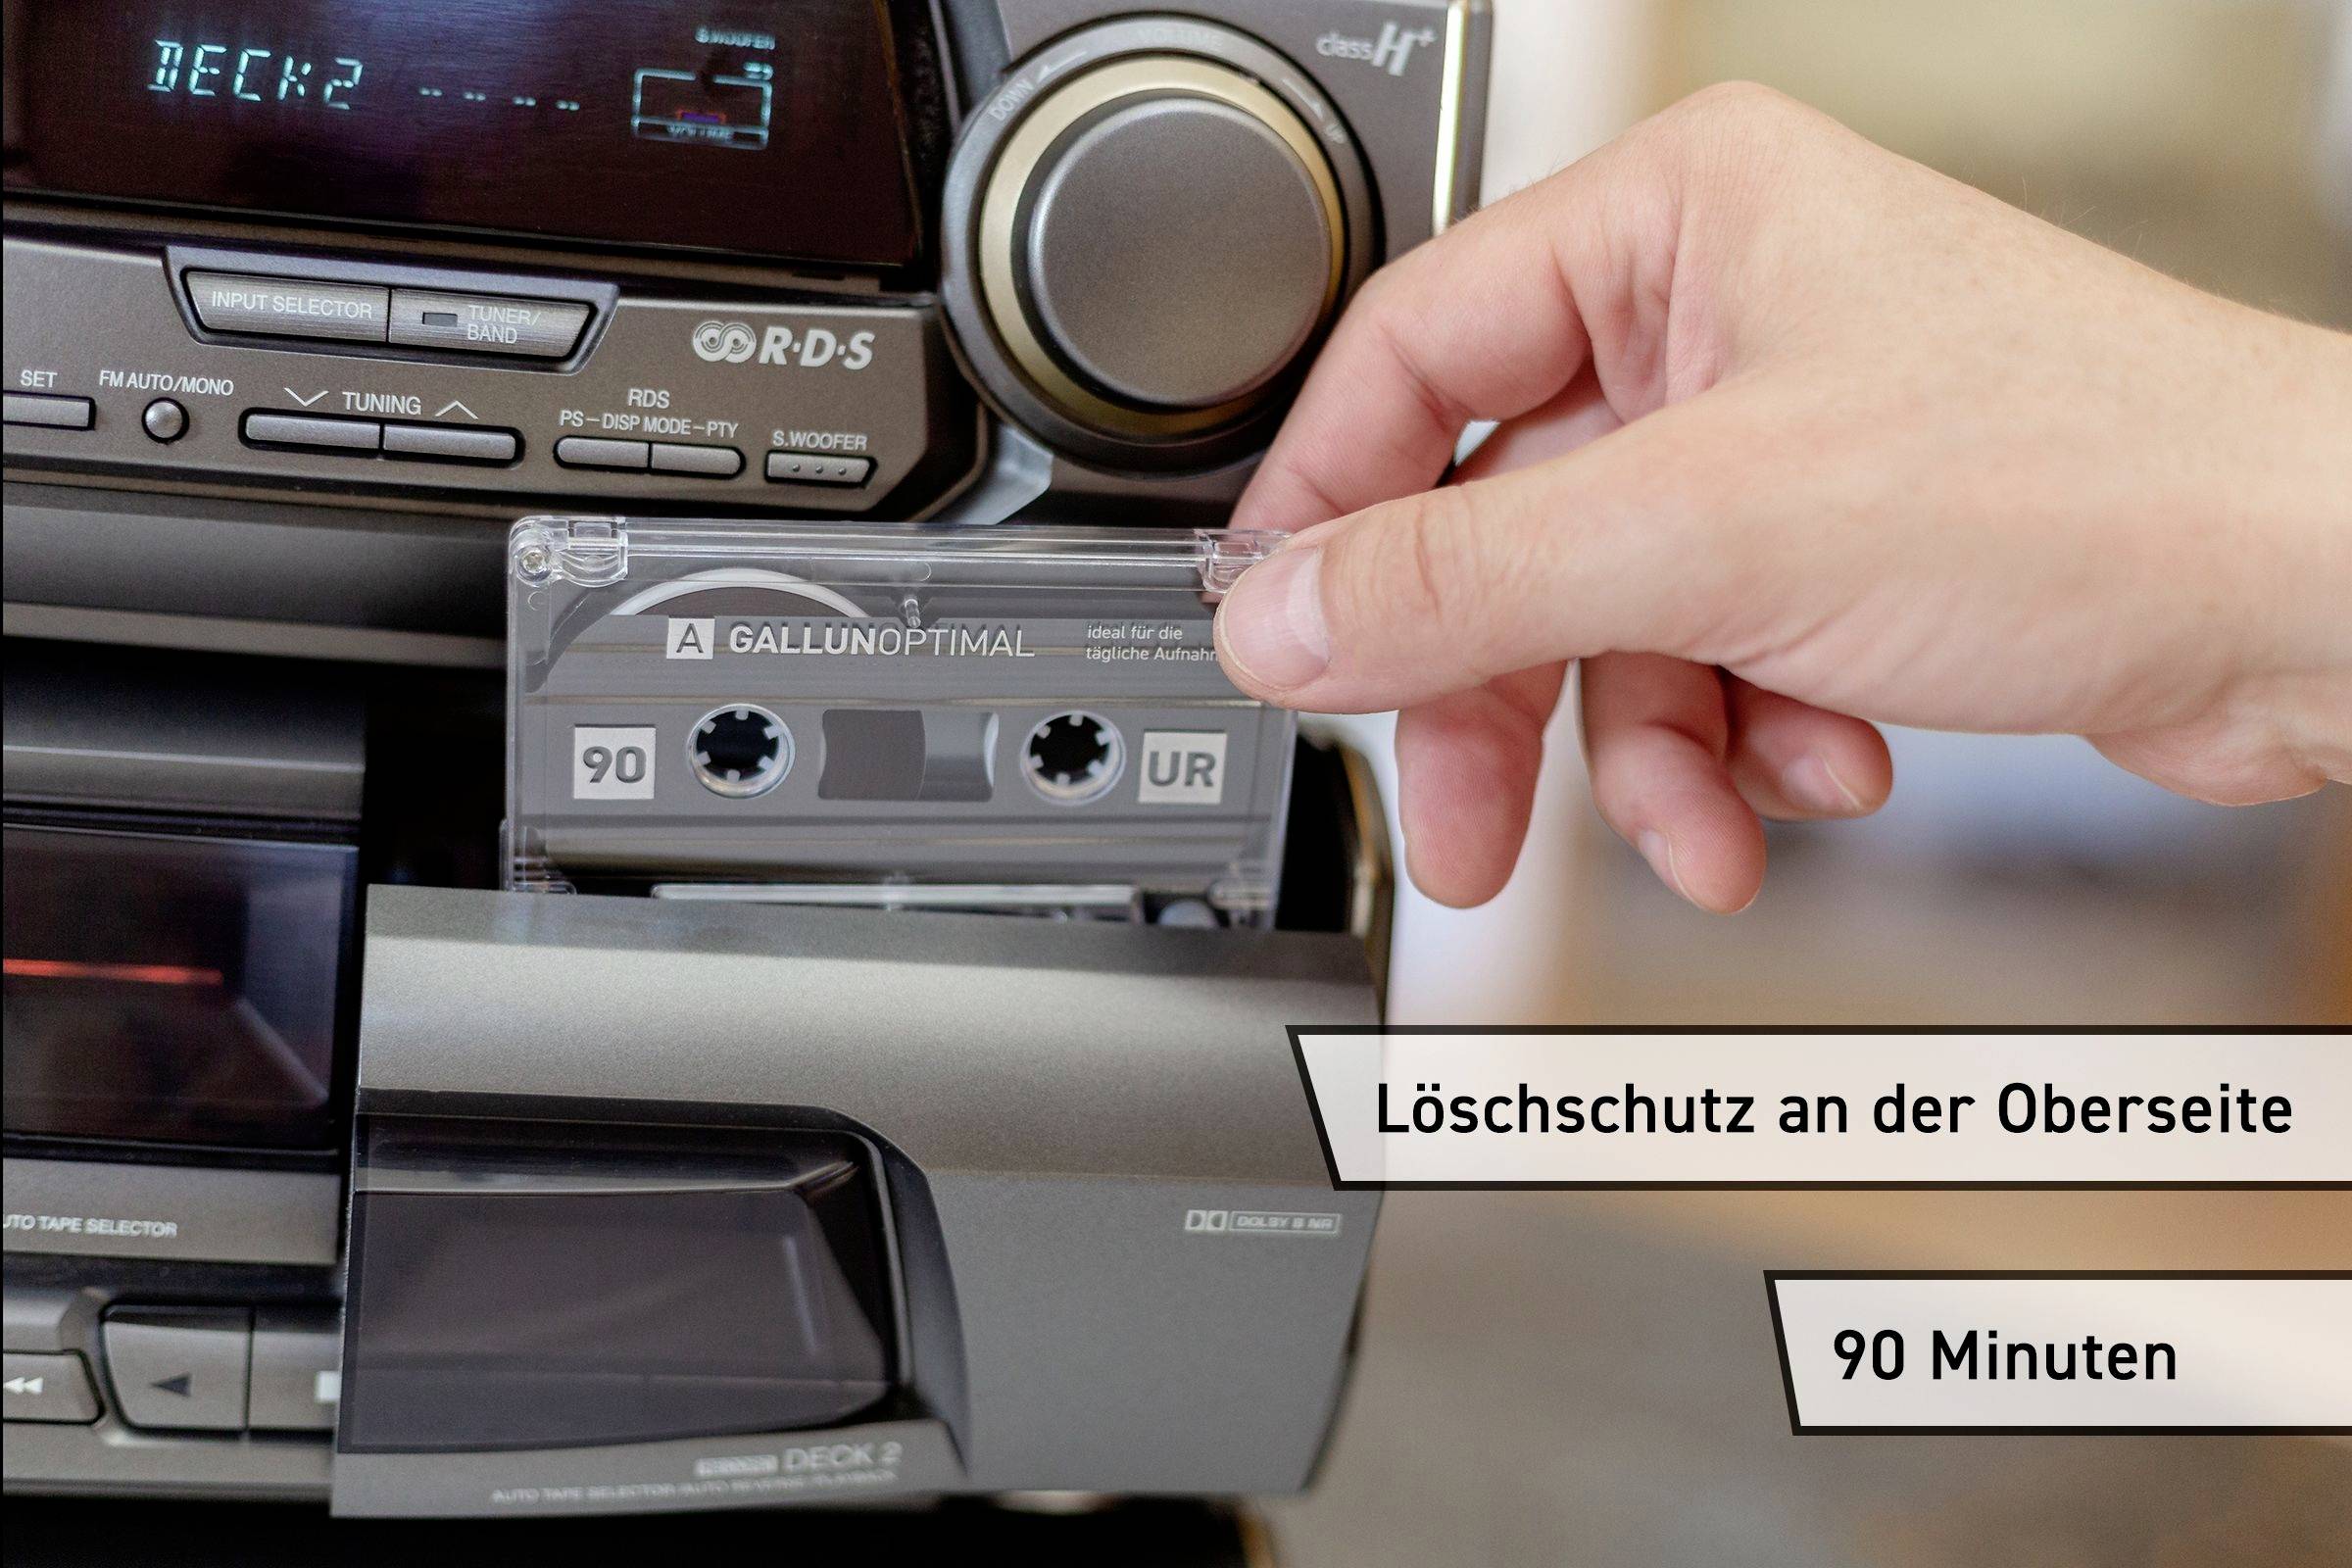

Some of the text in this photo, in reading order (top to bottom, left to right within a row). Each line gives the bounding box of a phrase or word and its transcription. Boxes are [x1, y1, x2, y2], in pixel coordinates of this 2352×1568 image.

[988, 80, 1035, 122] DOWN
[211, 291, 373, 320] INPUT SELECTOR
[468, 306, 542, 327] TUNER/
[466, 324, 518, 345] BAND
[20, 369, 58, 390] SET
[99, 371, 234, 397] FM AUTO/MONO
[342, 391, 422, 416] TUNING
[628, 388, 670, 409] RDS
[772, 429, 867, 452] S.WOOFER
[674, 623, 705, 654] A
[1088, 625, 1183, 640] ideal für die
[1086, 647, 1150, 662] tägliche
[582, 745, 647, 784] 90
[1148, 750, 1216, 787] UR
[37, 1215, 82, 1234] TAPE
[84, 1217, 178, 1239] SELECTOR
[879, 1441, 904, 1466] 2
